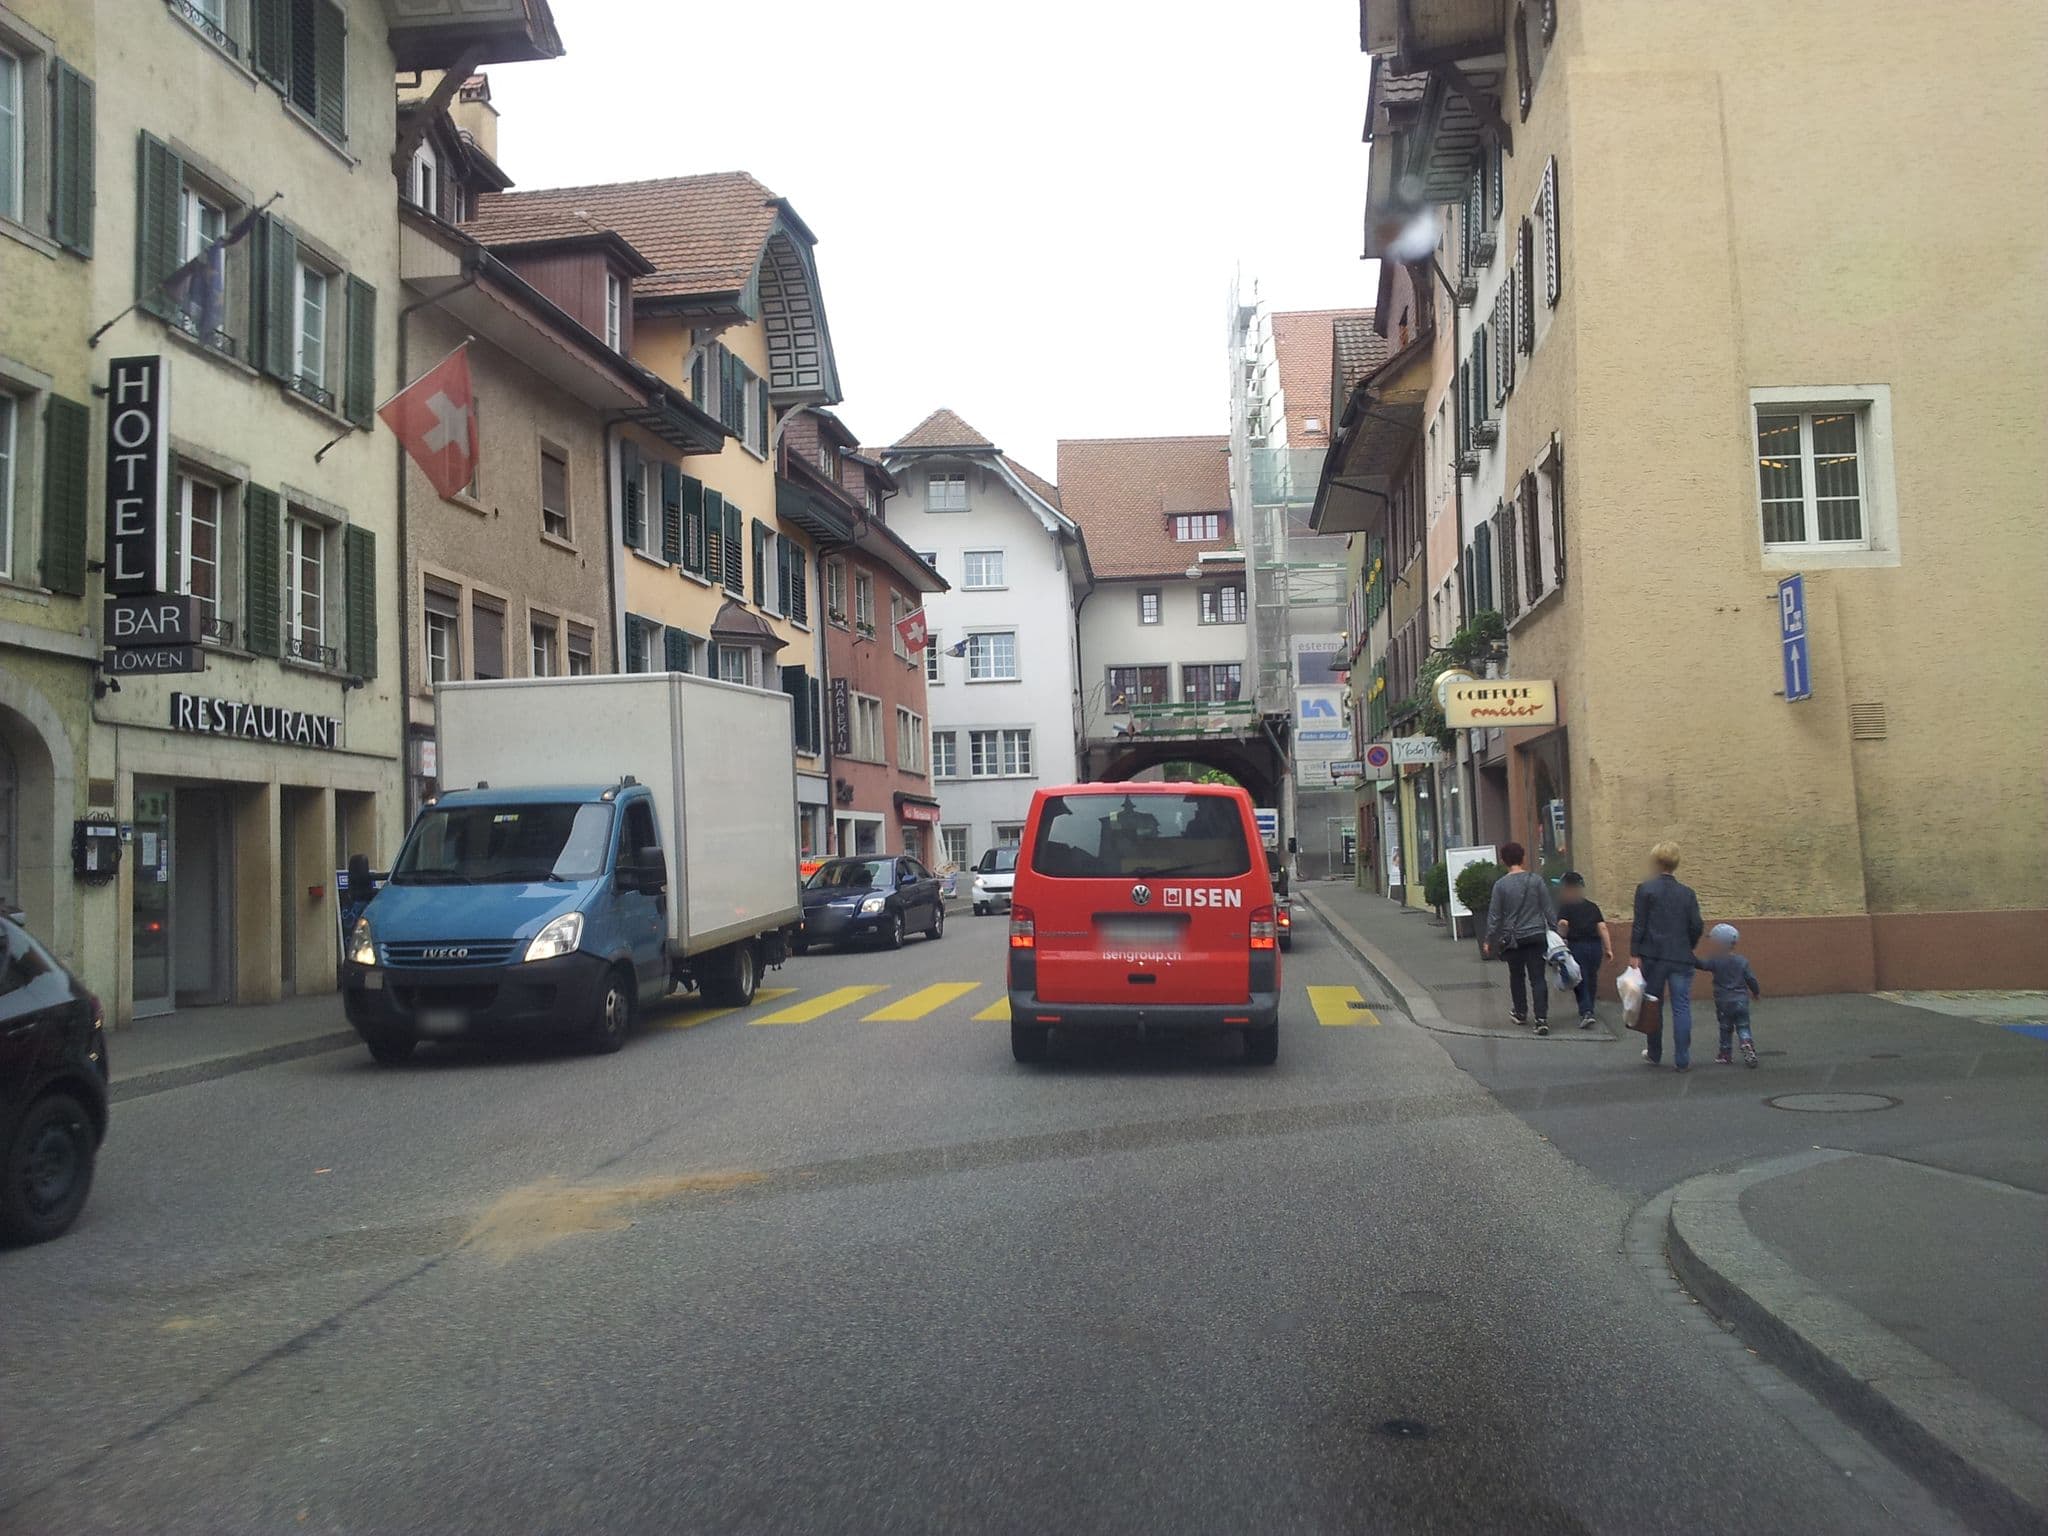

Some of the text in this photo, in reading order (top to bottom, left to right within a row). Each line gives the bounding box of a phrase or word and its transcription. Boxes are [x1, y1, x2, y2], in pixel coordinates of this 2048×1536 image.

[113, 365, 151, 581] HOTEL
[115, 606, 181, 636] BAR
[1782, 586, 1795, 632] P
[114, 651, 183, 670] LÖWEN
[1457, 688, 1531, 700] COIFFURE
[178, 693, 342, 748] RESTAURANT
[834, 680, 848, 751] HARLEKIN
[1186, 888, 1242, 908] ISEN
[423, 947, 468, 959] IVECO
